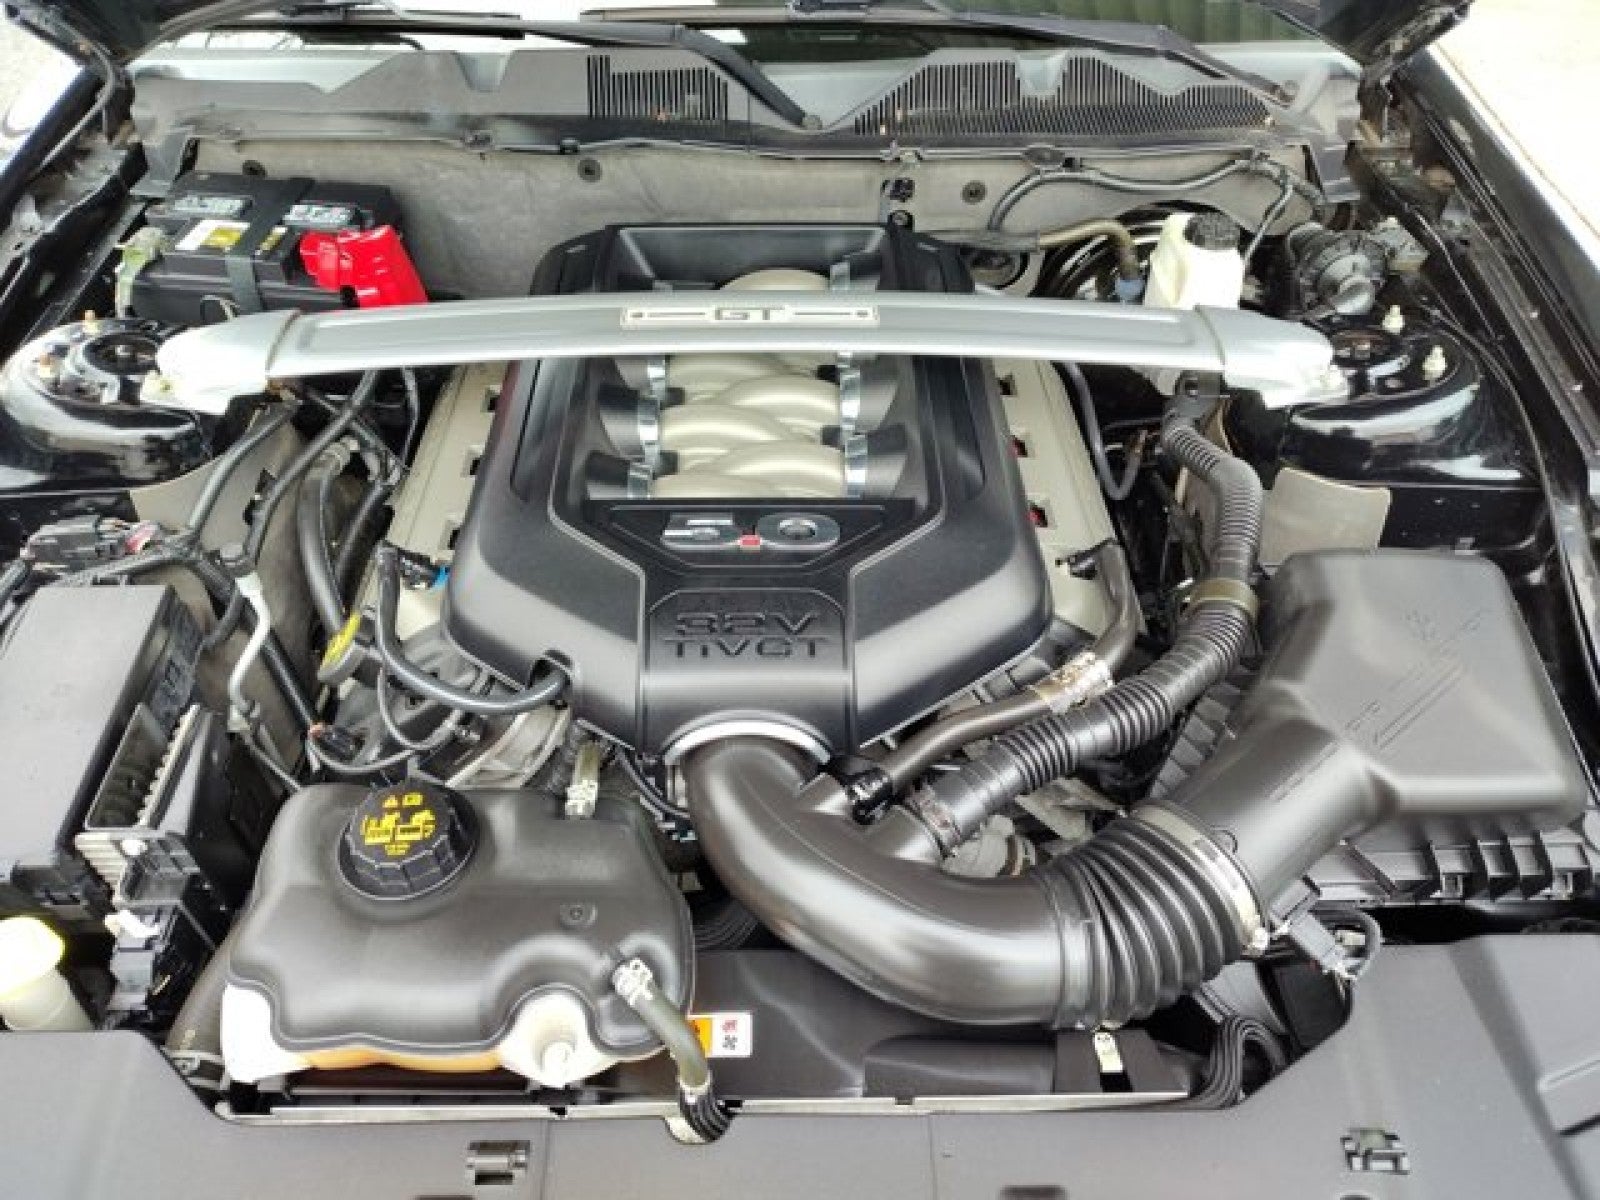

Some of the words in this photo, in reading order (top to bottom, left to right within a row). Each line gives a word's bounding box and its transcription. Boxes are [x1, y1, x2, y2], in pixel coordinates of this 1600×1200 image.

[714, 306, 785, 321] GT
[660, 512, 841, 552] 5.0
[675, 612, 818, 636] 32V
